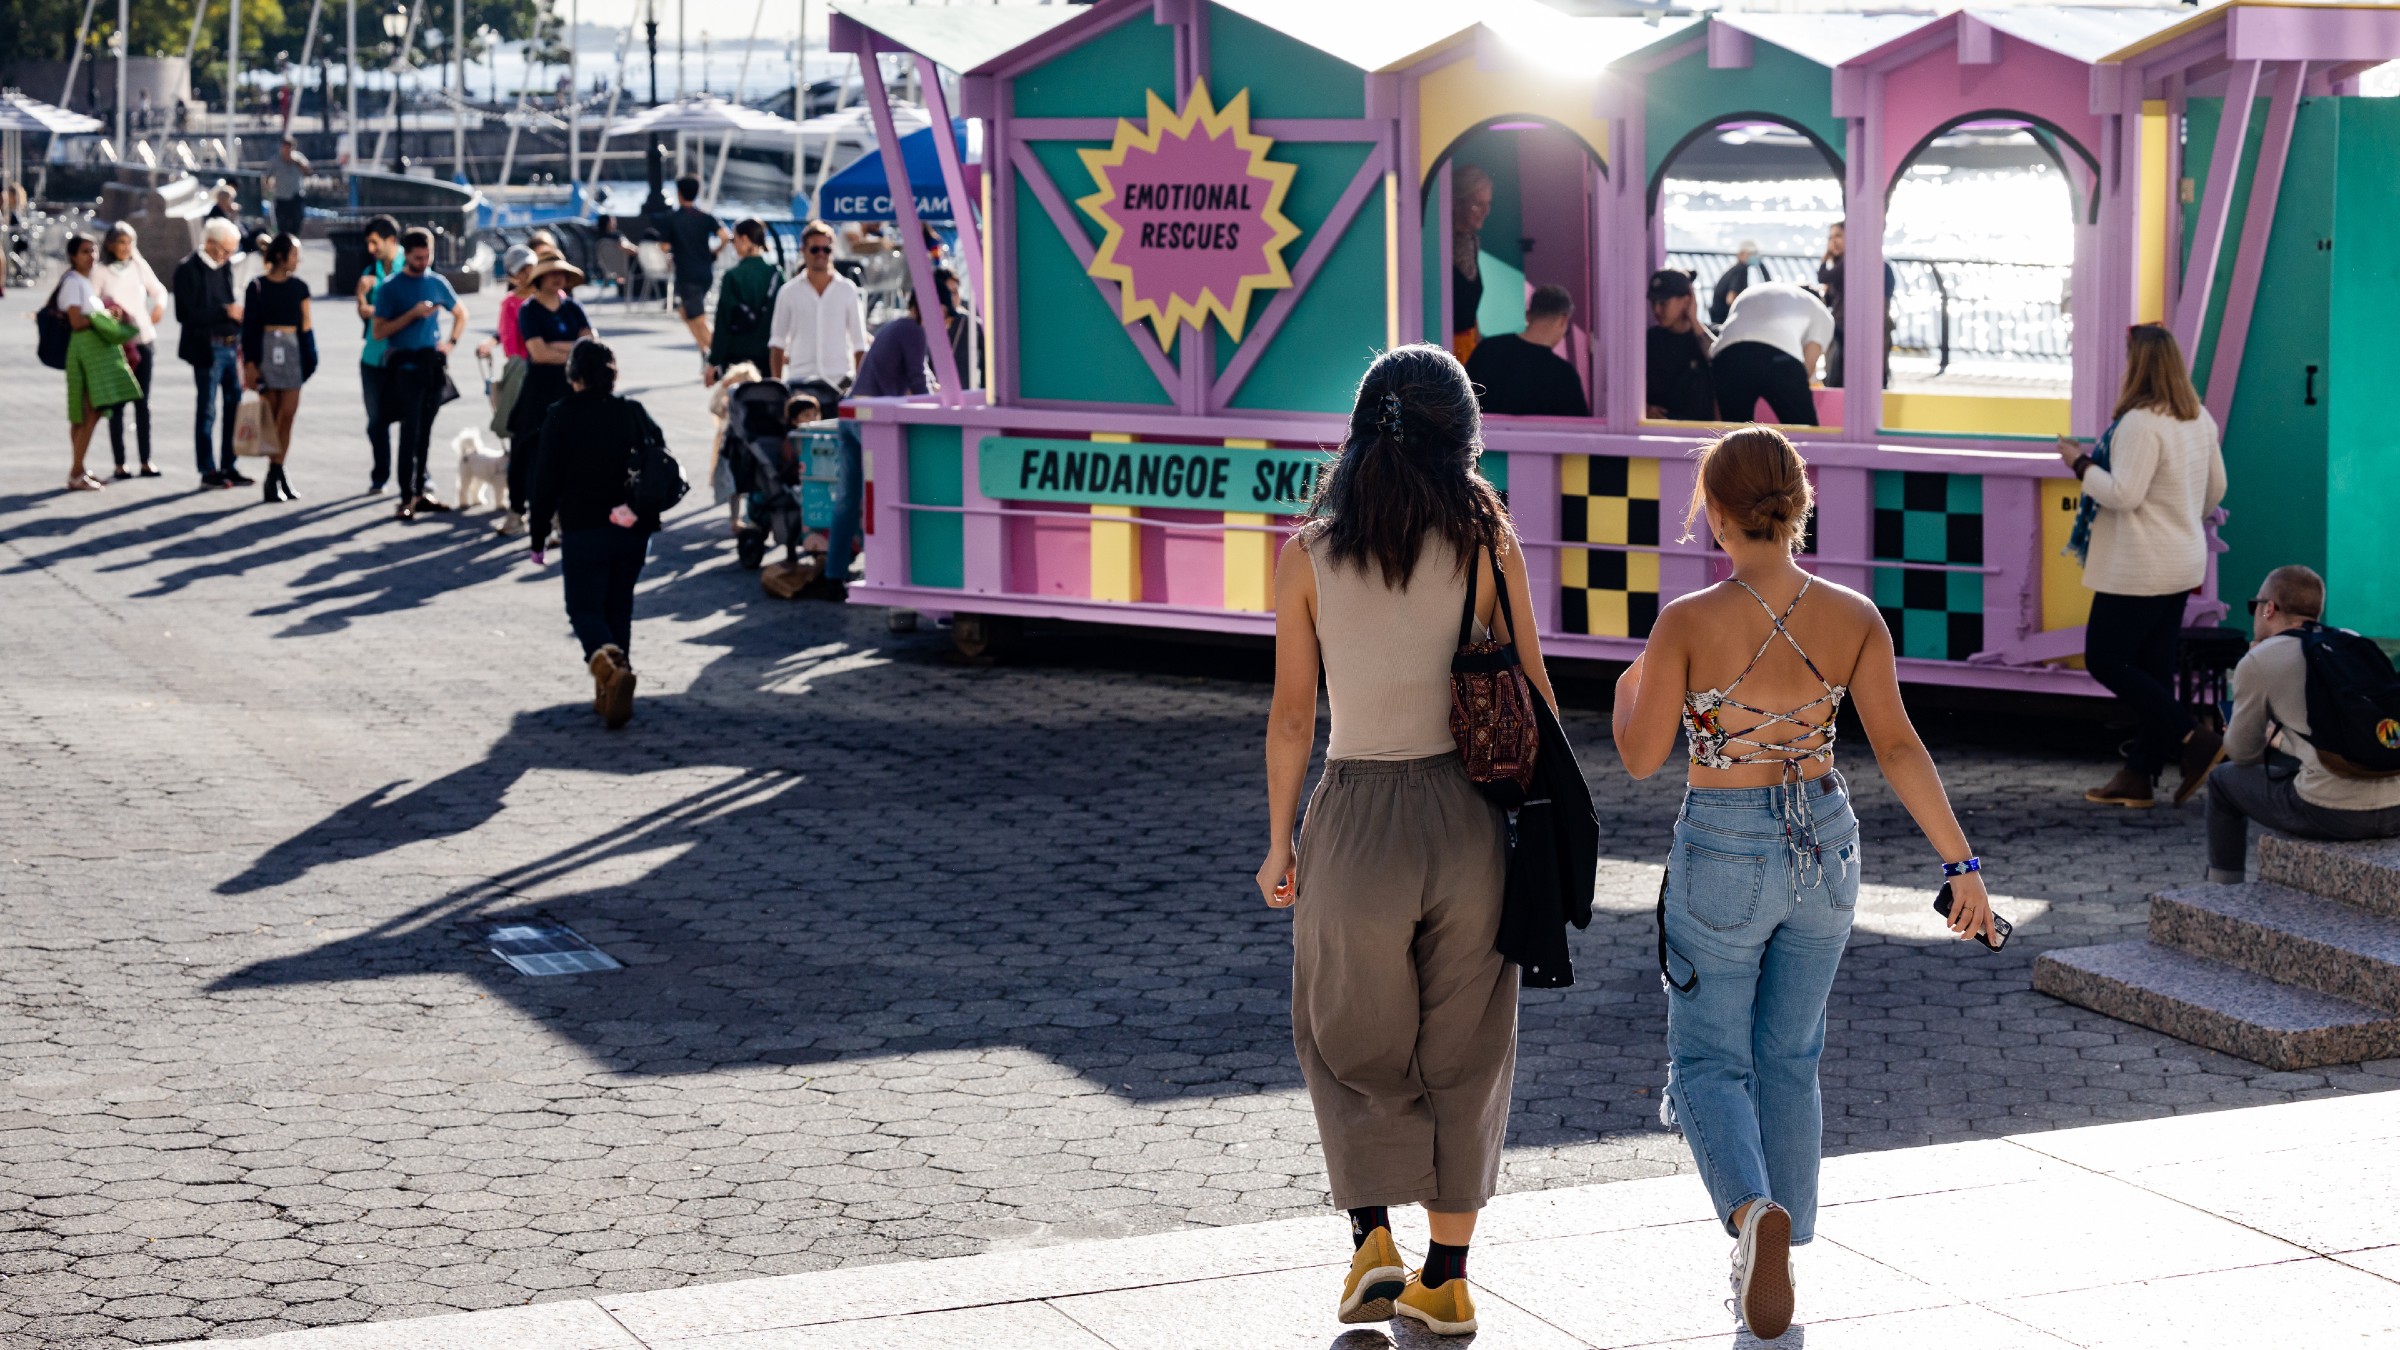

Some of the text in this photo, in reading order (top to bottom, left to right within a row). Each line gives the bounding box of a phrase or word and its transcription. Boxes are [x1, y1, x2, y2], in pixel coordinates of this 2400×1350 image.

[833, 196, 949, 214] ICE CAM
[1123, 183, 1251, 211] EMOTIONAL
[1140, 221, 1240, 250] RESCUES
[1019, 450, 1230, 499] FANDANGOE
[2061, 496, 2078, 511] BI
